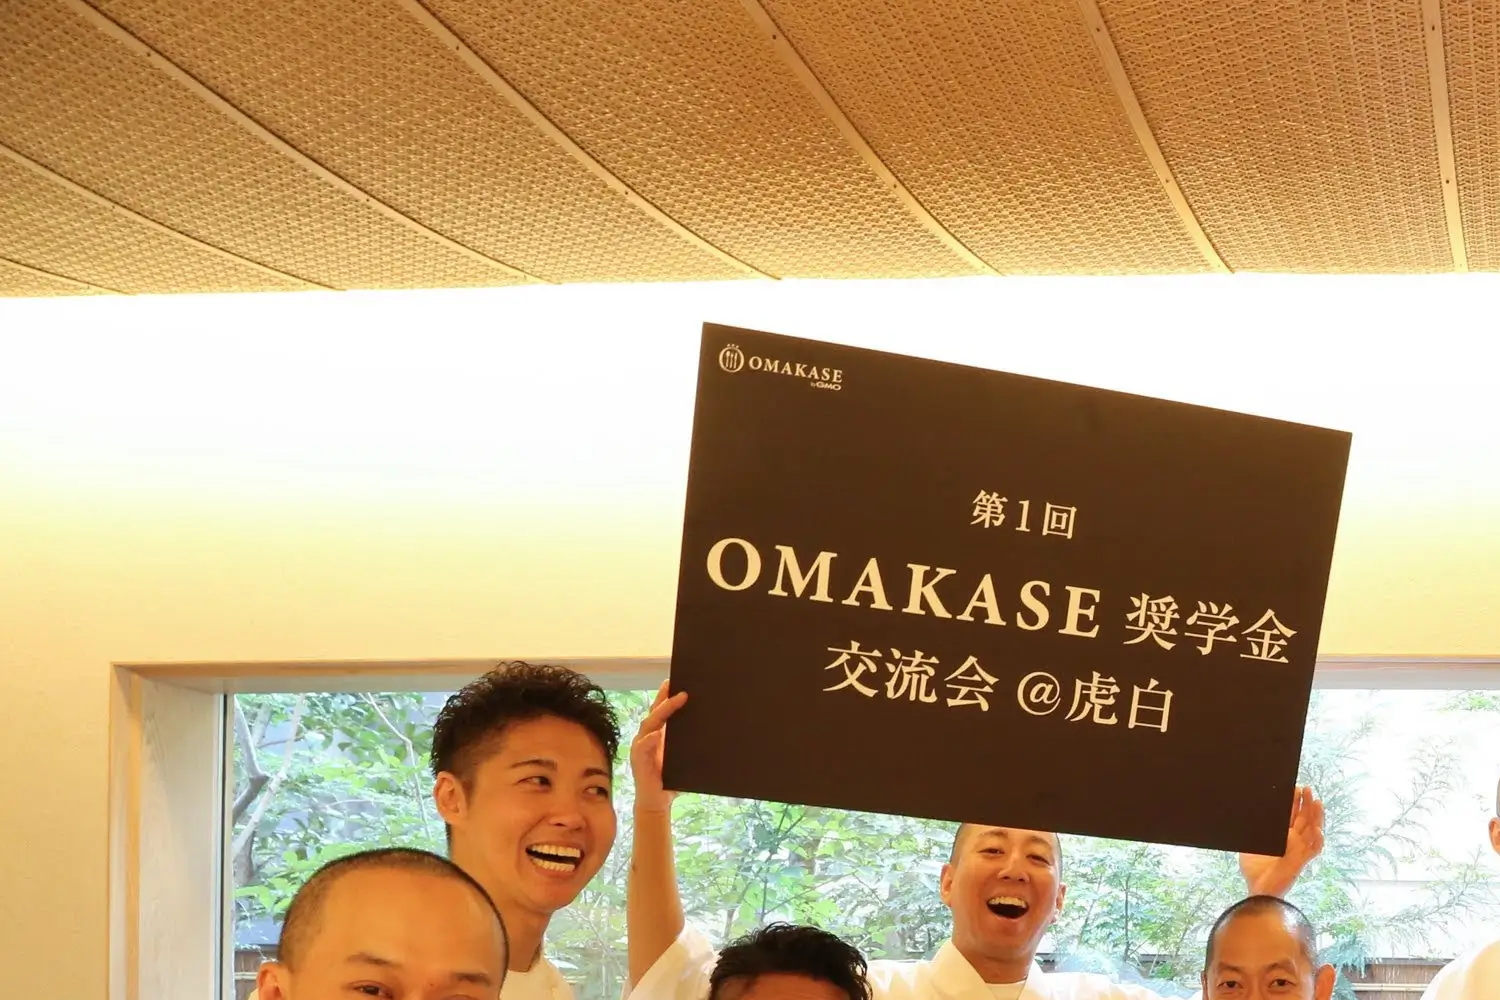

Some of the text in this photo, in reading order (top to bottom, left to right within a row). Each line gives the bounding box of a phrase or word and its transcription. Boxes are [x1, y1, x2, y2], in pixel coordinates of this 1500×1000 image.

[748, 356, 843, 383] OMAKASE
[816, 381, 842, 391] GMO
[970, 489, 1078, 540] 第1回
[706, 537, 1298, 664] OMAKASE 奨学金
[822, 640, 1174, 733] 交流会 @虎白
